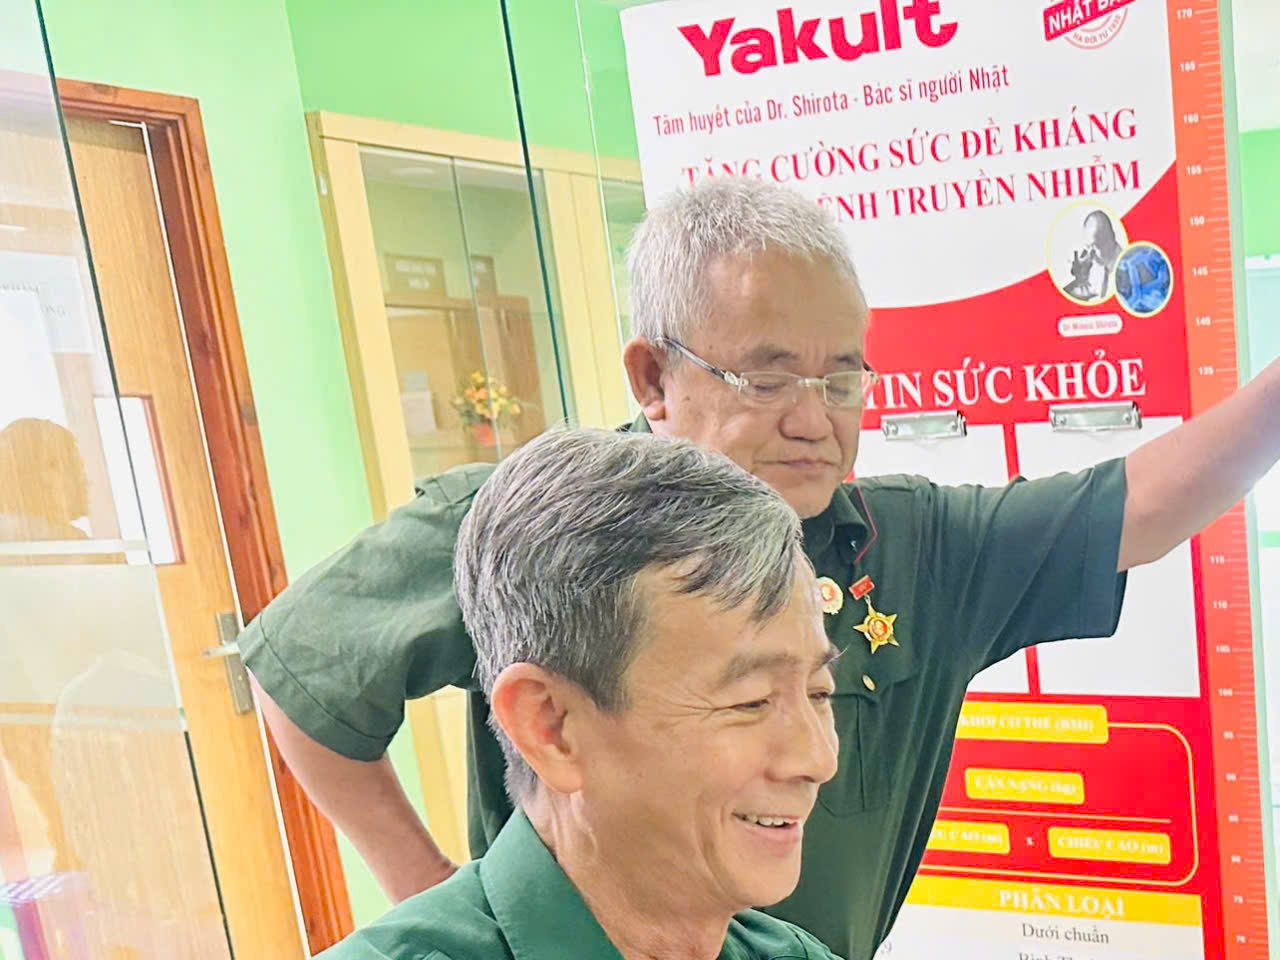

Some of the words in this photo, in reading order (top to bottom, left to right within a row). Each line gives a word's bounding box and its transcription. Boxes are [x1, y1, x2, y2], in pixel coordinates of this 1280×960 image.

[677, 0, 958, 77] Yakult
[766, 98, 788, 121] Dr.
[792, 90, 849, 117] Shirota
[918, 71, 963, 103] người
[771, 140, 880, 183] CƯỜNG
[889, 127, 951, 169] SỨC
[961, 116, 1003, 160] ĐỀ
[1013, 105, 1136, 152] KHÁNG
[886, 168, 1016, 218] TRUYỀN
[1026, 155, 1140, 202] NHIỄM
[932, 356, 1014, 408] SỨC
[1022, 348, 1146, 402] KHỎE
[999, 888, 1060, 912] PHÂN
[1067, 895, 1125, 920] LOẠI
[1022, 922, 1059, 940] Dưới
[1064, 924, 1109, 943] chuẩn
